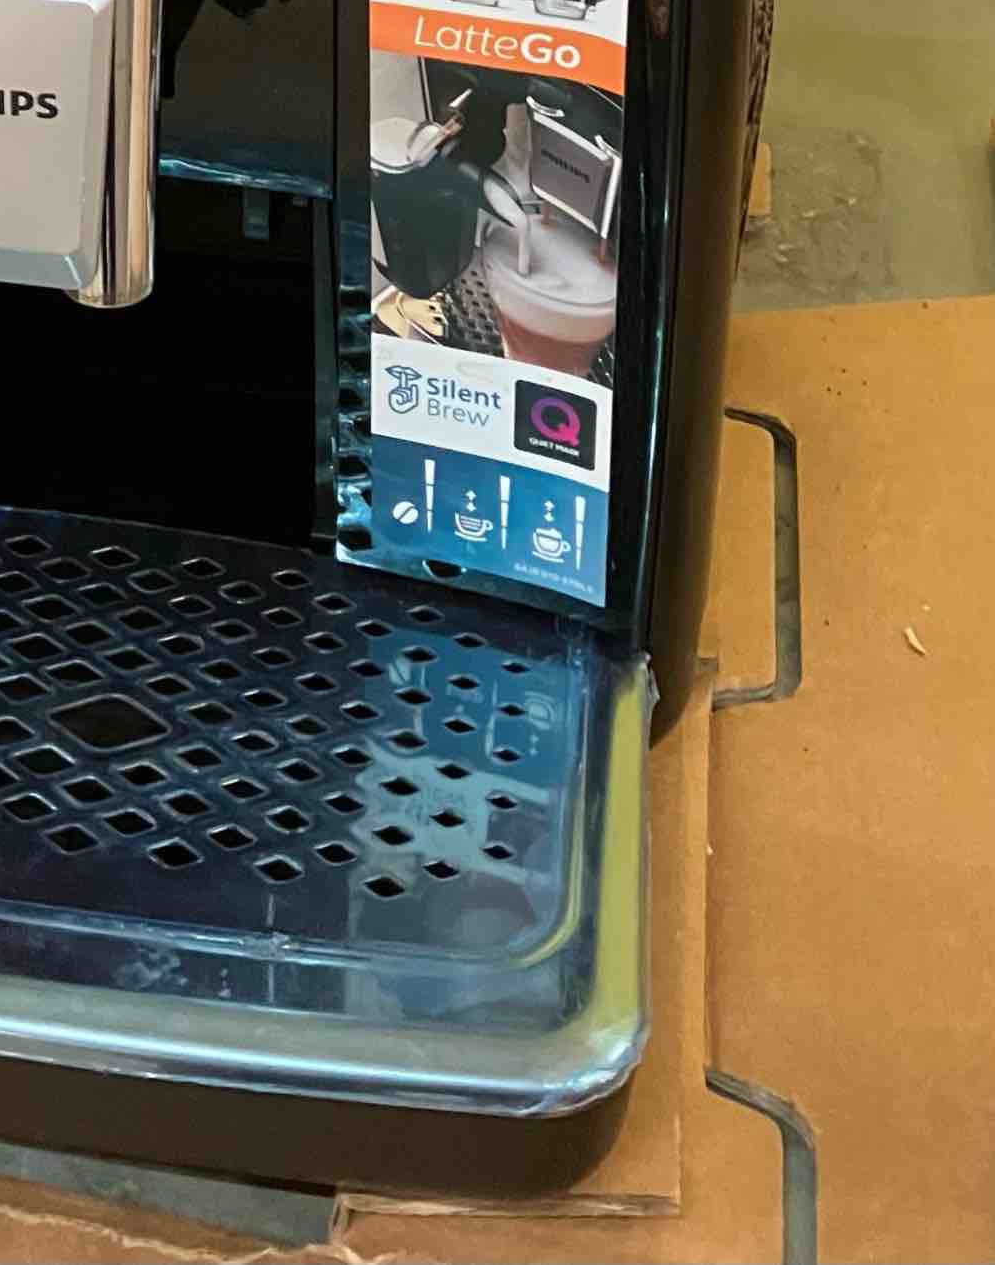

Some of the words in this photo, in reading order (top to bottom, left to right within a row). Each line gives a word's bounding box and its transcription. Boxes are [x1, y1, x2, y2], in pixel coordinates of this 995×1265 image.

[414, 15, 581, 69] LatteGo
[427, 377, 501, 410] Silent
[427, 399, 490, 427] Brew
